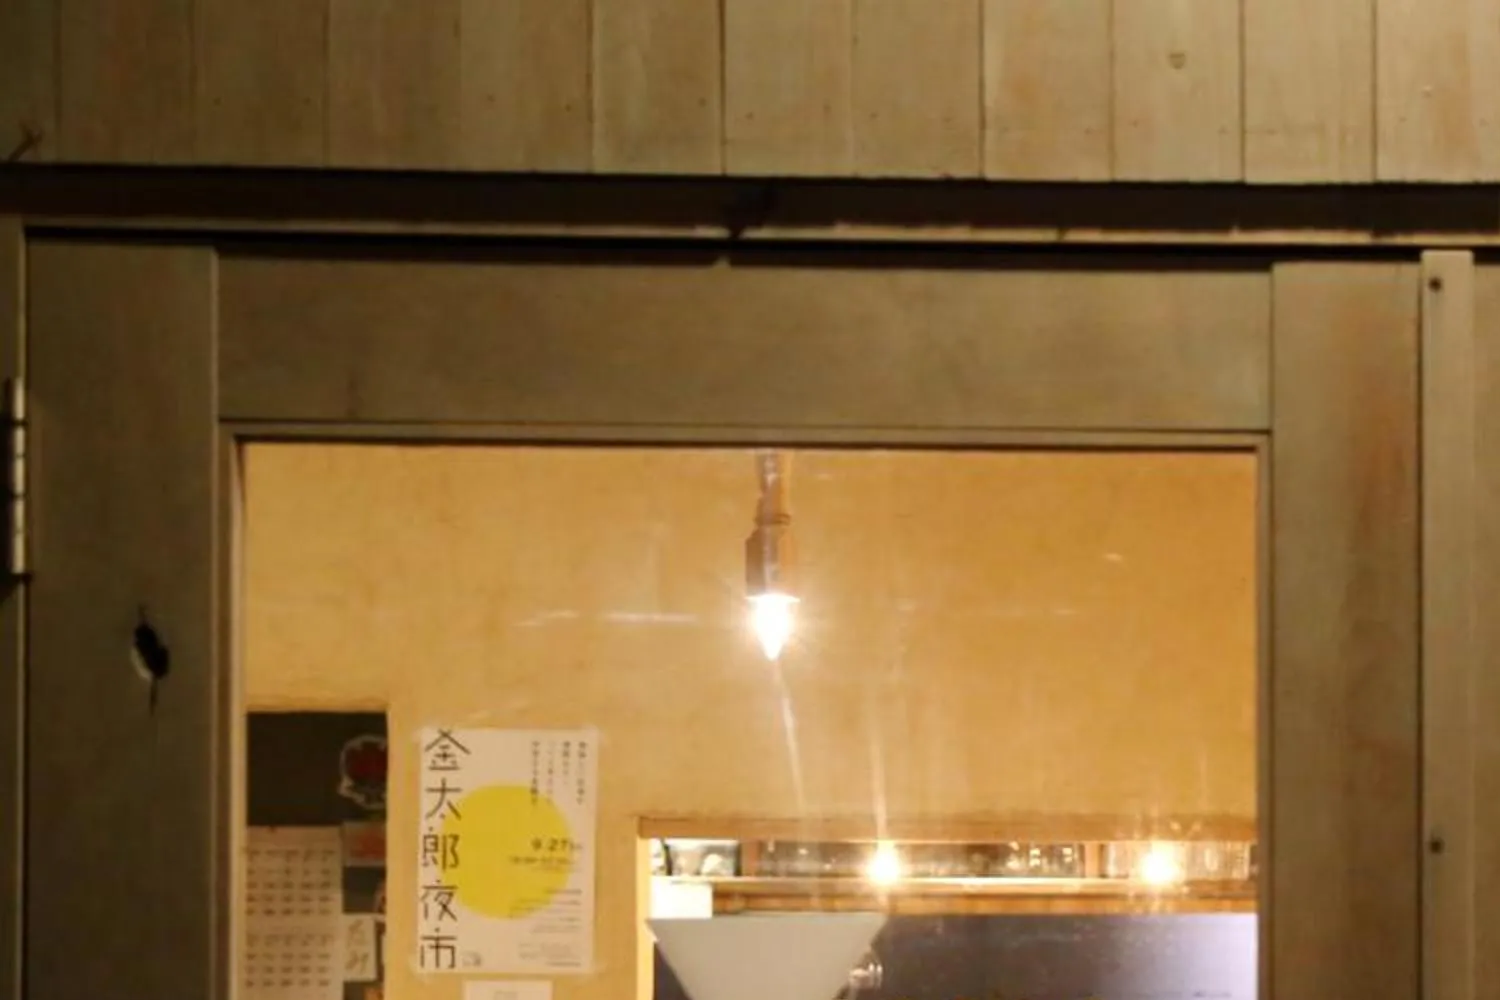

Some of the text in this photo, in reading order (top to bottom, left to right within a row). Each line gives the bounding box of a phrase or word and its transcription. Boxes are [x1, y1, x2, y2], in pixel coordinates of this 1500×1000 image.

[420, 728, 471, 969] 金太郎夜市
